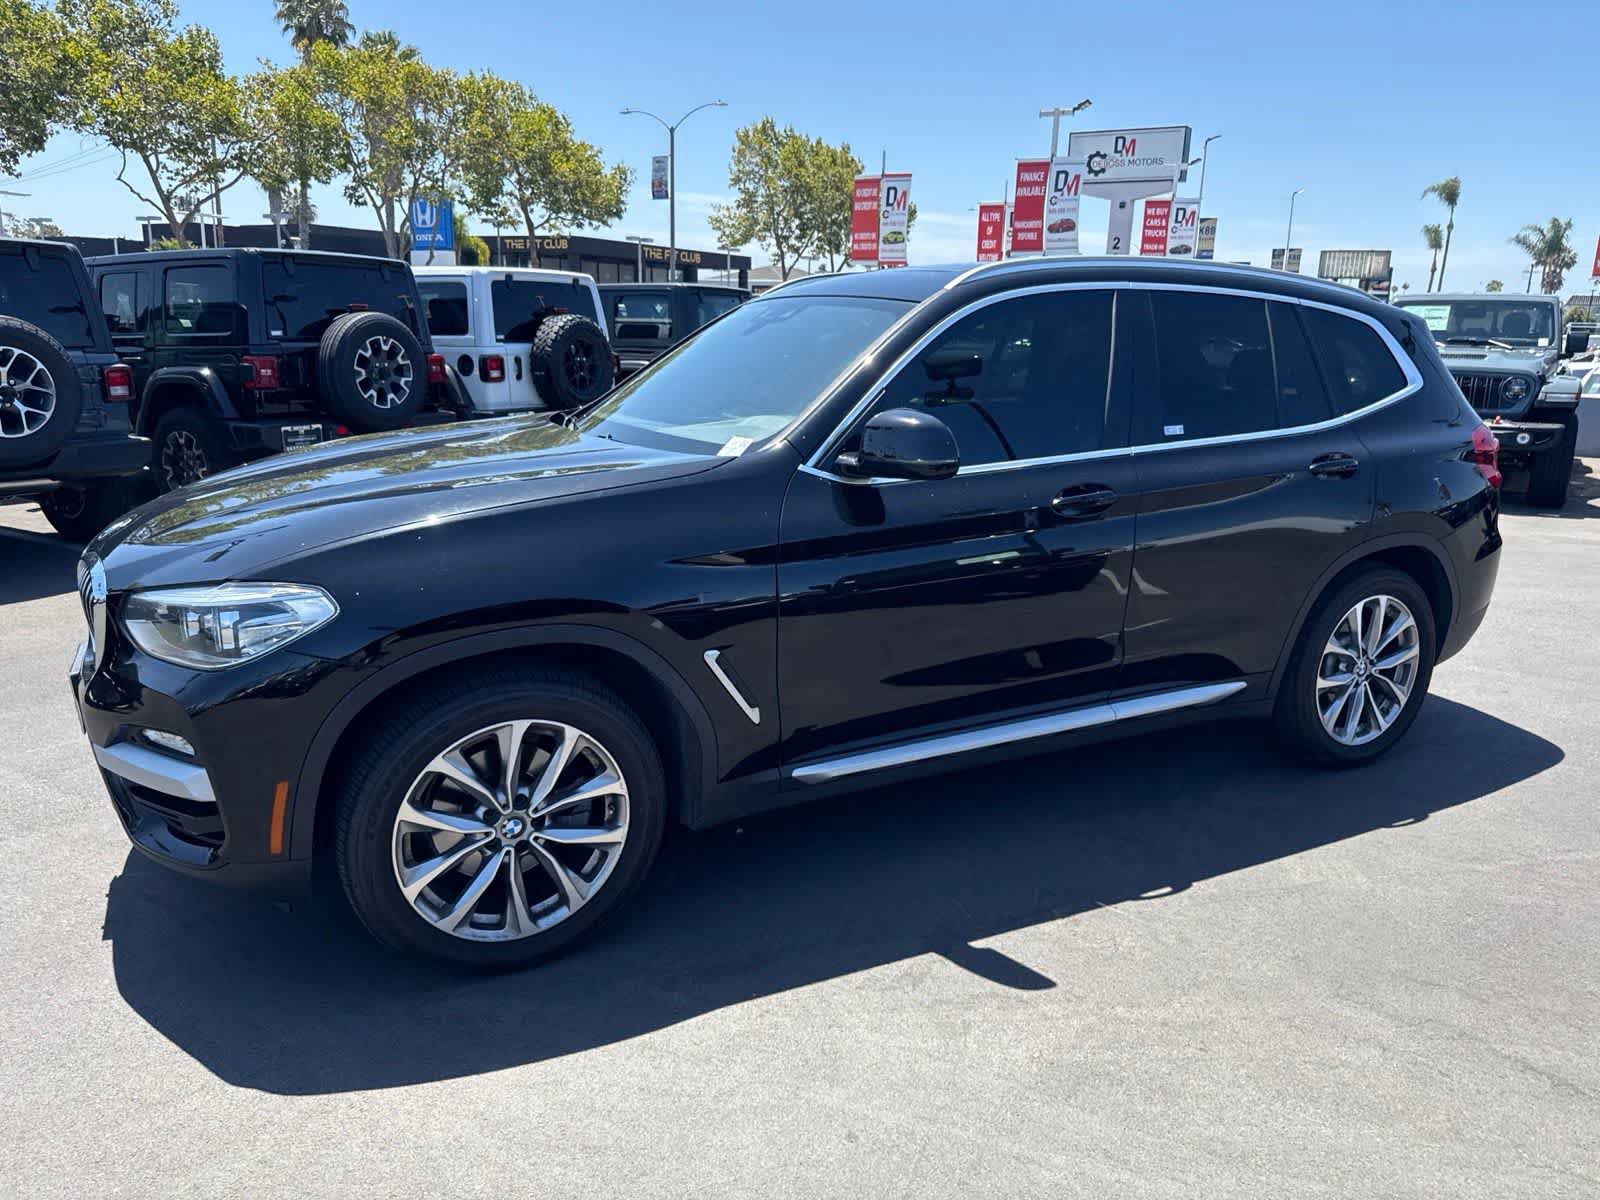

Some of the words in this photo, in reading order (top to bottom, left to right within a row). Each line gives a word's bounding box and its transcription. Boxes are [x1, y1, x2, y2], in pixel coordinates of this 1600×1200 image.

[1127, 156, 1164, 168] MOTORS
[1020, 171, 1044, 182] FINANCE
[1016, 185, 1046, 197] AVAILABLE
[1146, 207, 1156, 216] WE
[1156, 207, 1169, 216] BUY
[982, 212, 990, 222] ALL
[1146, 218, 1161, 226] CARS
[1144, 229, 1166, 238] TRUCKS
[504, 239, 525, 249] THE
[526, 239, 542, 249] FT
[544, 239, 569, 249] CLUB
[1112, 236, 1121, 250] 2
[643, 246, 663, 260] THE
[680, 252, 702, 264] CLUB
